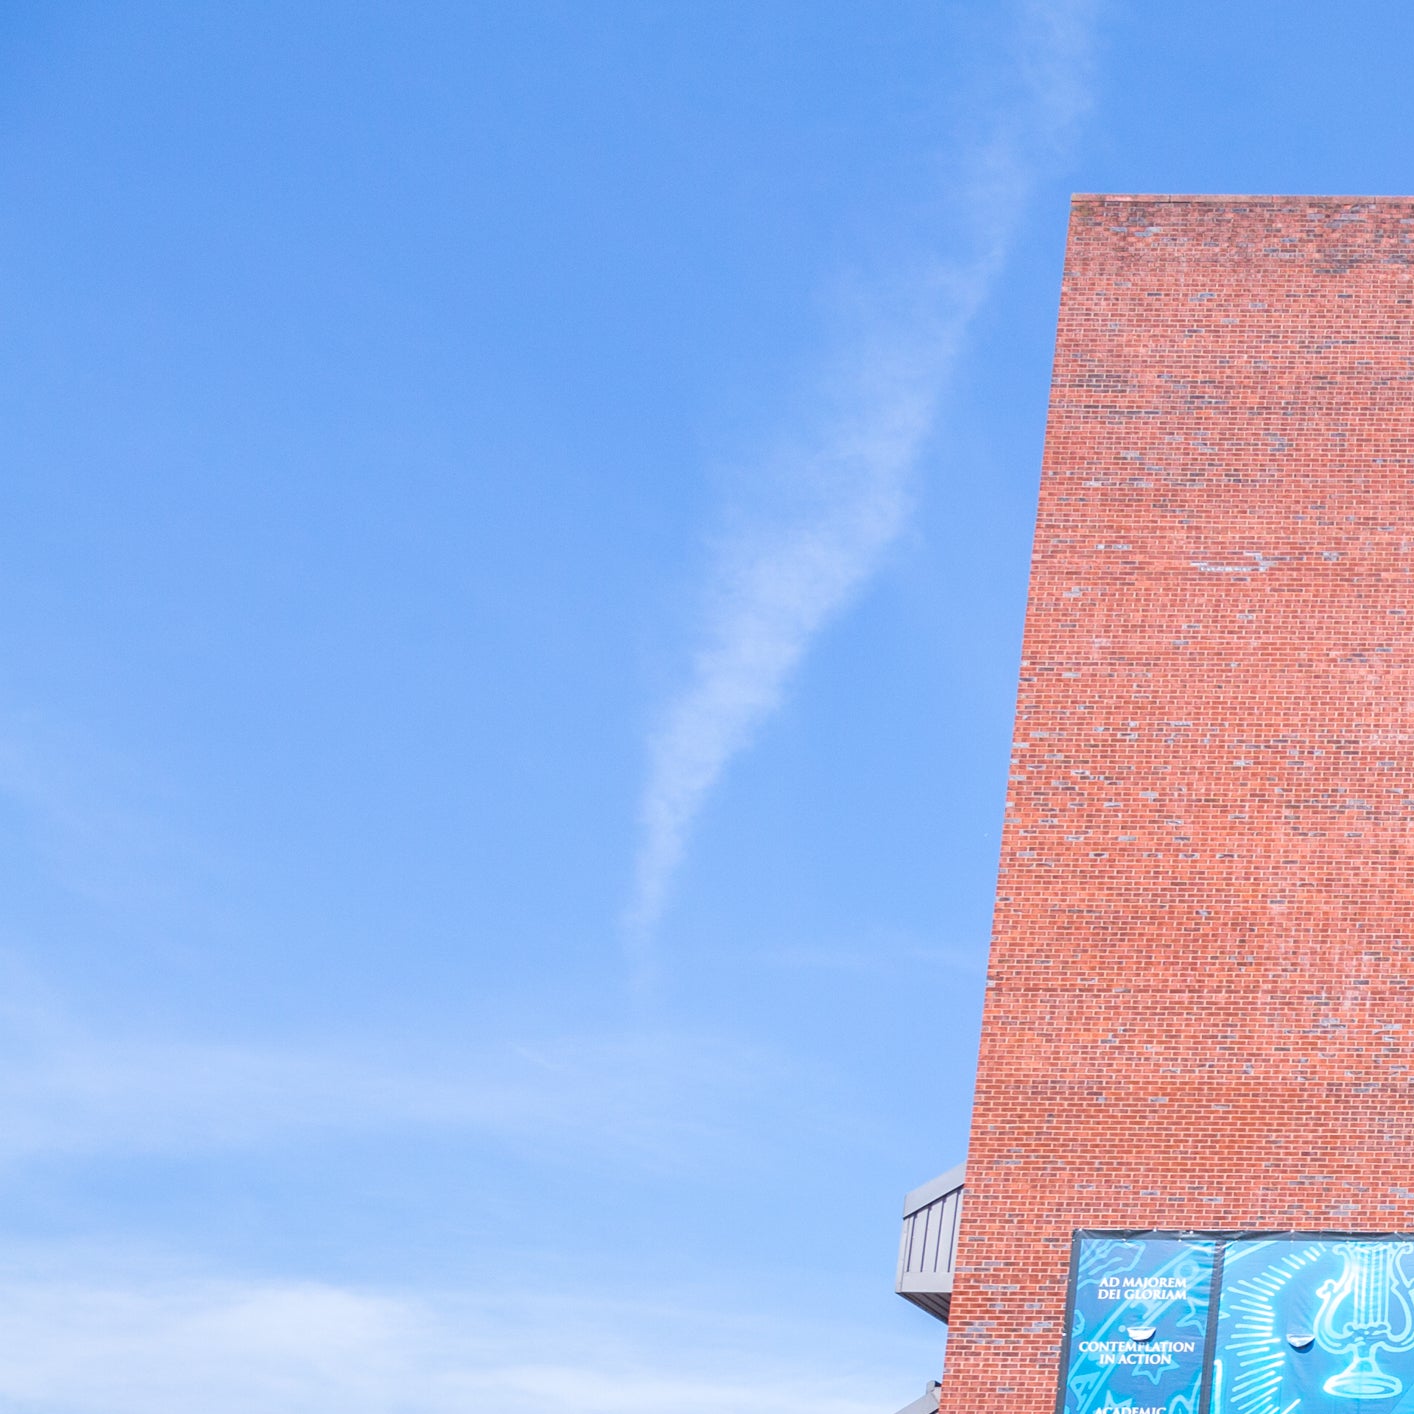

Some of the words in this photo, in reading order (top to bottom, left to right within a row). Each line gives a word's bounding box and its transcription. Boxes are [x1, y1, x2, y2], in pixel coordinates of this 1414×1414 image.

[1099, 1277, 1120, 1288] AD
[1122, 1278, 1187, 1291] MAJOREM
[1097, 1289, 1121, 1300] DEI
[1124, 1289, 1187, 1300] GLORIAM
[1078, 1341, 1195, 1353] CONTEMPLATION
[1099, 1354, 1115, 1365] IN
[1118, 1354, 1172, 1365] ACTION
